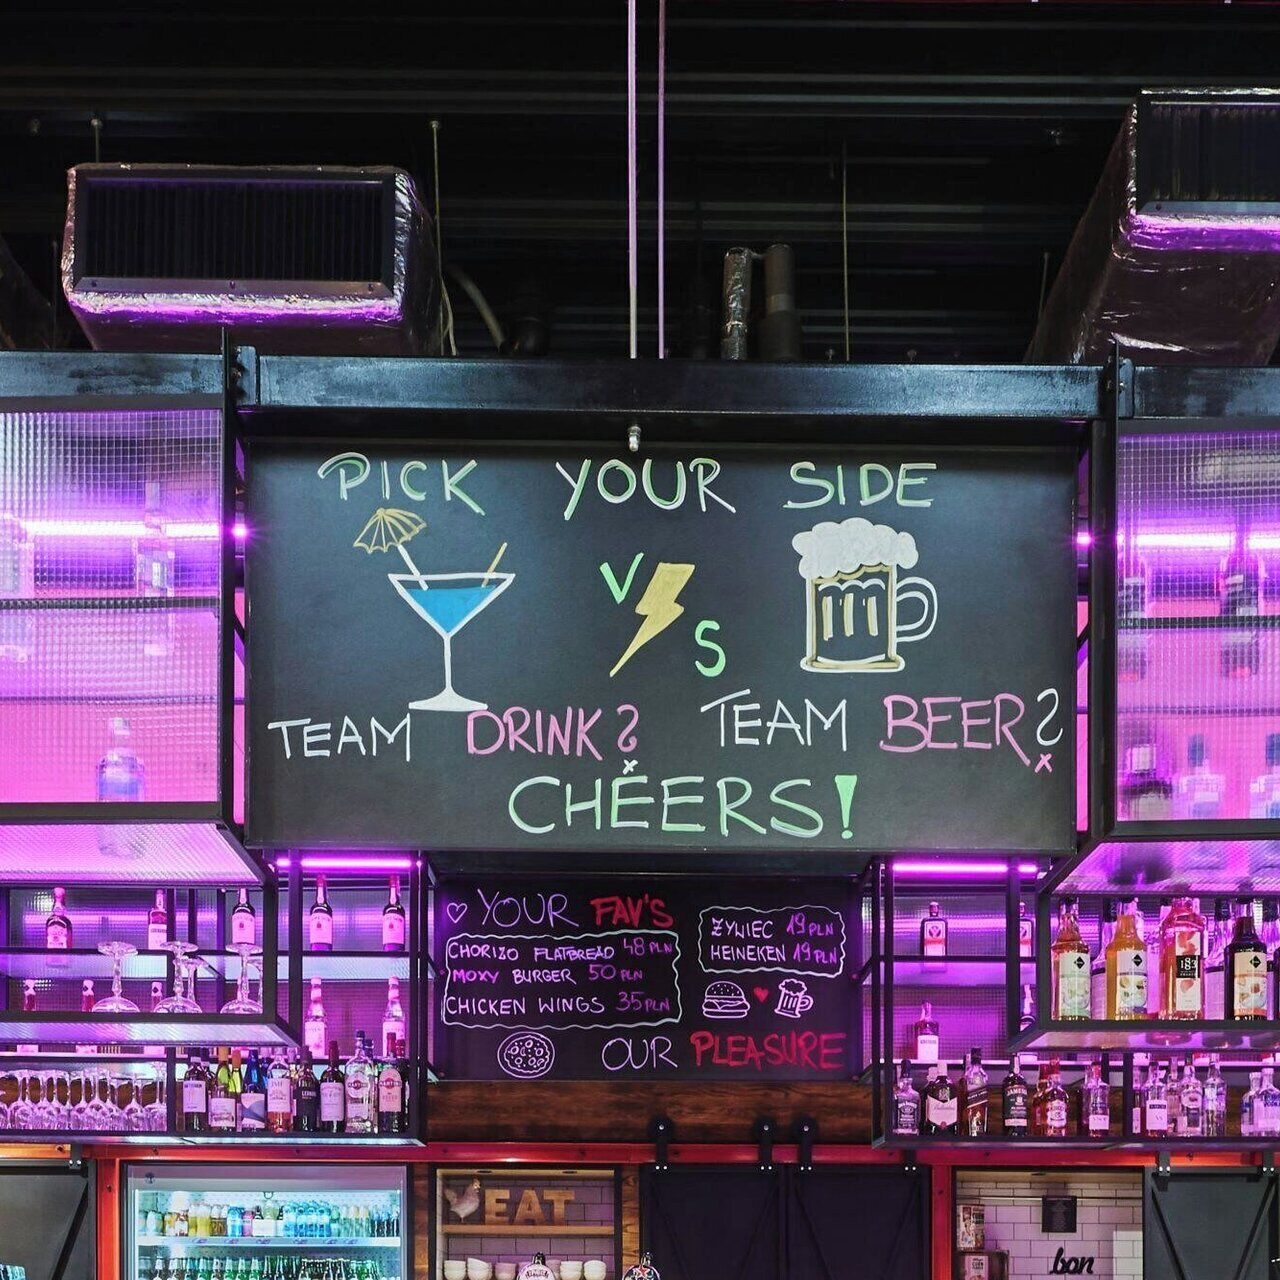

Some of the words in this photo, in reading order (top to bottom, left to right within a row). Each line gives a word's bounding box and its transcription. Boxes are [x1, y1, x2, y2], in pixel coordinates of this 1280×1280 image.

[317, 451, 486, 517] PICK
[555, 457, 737, 521] YOUR
[783, 461, 937, 508] SIDE
[599, 552, 644, 604] V
[694, 619, 726, 678] S
[267, 712, 411, 762] TEAM
[700, 688, 847, 752] TEAM
[508, 773, 858, 840] CHEERS!
[477, 888, 580, 928] YOUR
[590, 893, 674, 929] FAV'S
[786, 912, 806, 936] 19
[808, 922, 834, 936] PLN
[447, 941, 519, 961] CHORIZO
[533, 945, 615, 962] FLATBREAD
[622, 936, 645, 957] 48
[649, 941, 673, 954] PLN
[710, 944, 787, 963] HEINEKEN
[792, 941, 812, 963] 19
[814, 947, 838, 964] PLN
[452, 969, 500, 984] MOXY
[512, 968, 577, 985] BURGER
[588, 963, 617, 981] 50
[620, 970, 643, 982] PLN
[446, 996, 526, 1016] CHICKEN
[538, 997, 605, 1014] WINGS
[615, 990, 644, 1011] 35
[645, 998, 670, 1012] PLN
[601, 1036, 679, 1071] OUR
[690, 1029, 847, 1072] PLEASURE
[483, 1188, 576, 1226] EAT
[1049, 1246, 1095, 1276] bon
